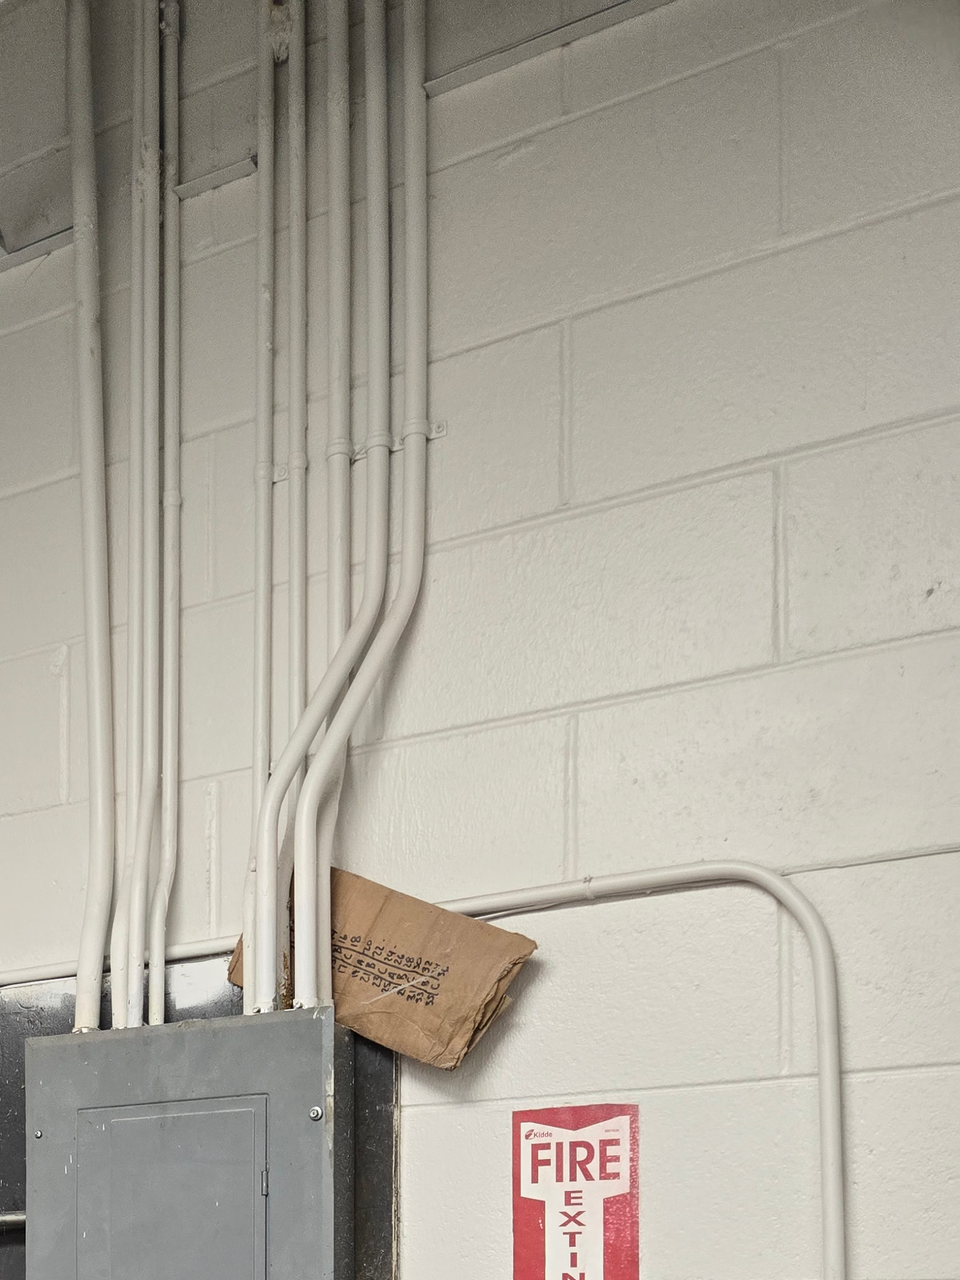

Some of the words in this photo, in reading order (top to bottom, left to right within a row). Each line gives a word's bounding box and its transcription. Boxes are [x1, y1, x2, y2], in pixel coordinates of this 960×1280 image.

[338, 934, 348, 944] 16
[338, 964, 348, 974] 17
[350, 935, 361, 948] 18
[372, 945, 385, 957] 22
[364, 962, 376, 970] B
[377, 967, 388, 975] C
[383, 950, 397, 961] 24
[388, 971, 397, 980] A
[393, 954, 405, 965] 26
[402, 956, 415, 968] 28
[421, 960, 433, 973] 32
[359, 972, 372, 983] 21
[533, 1131, 553, 1139] Kidde
[530, 1138, 621, 1185] FIRE
